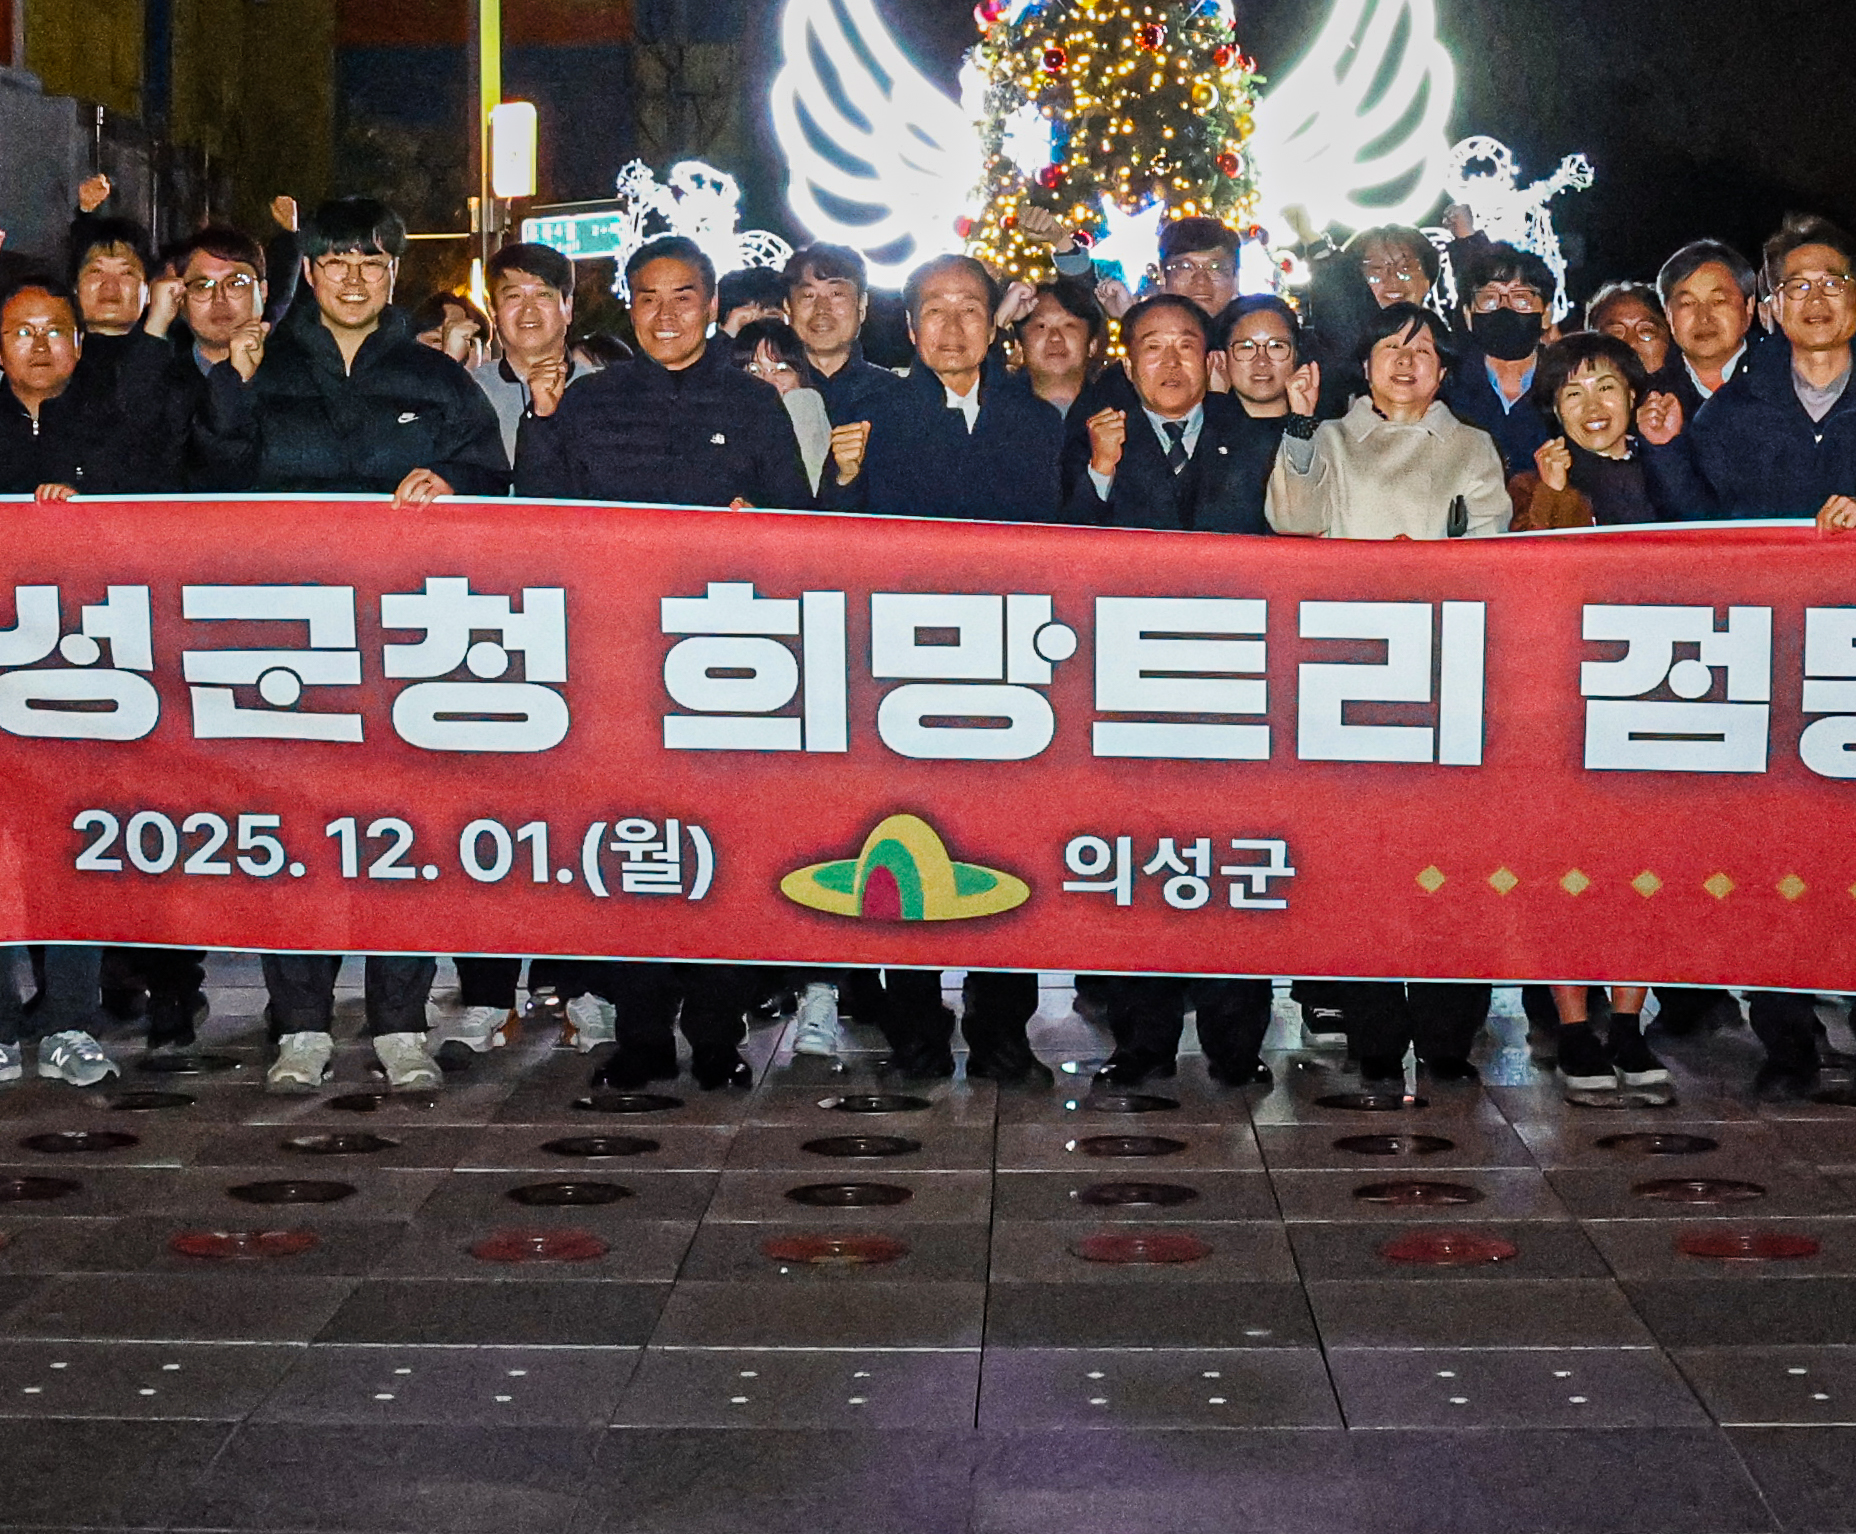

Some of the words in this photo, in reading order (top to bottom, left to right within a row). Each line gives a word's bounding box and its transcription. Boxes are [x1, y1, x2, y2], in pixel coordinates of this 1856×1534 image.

[660, 581, 1486, 767] 희망트리
[72, 809, 306, 878] 2025.
[325, 817, 439, 881] 12.
[458, 817, 714, 900] 01.(월)
[1062, 835, 1296, 909] 의성군
